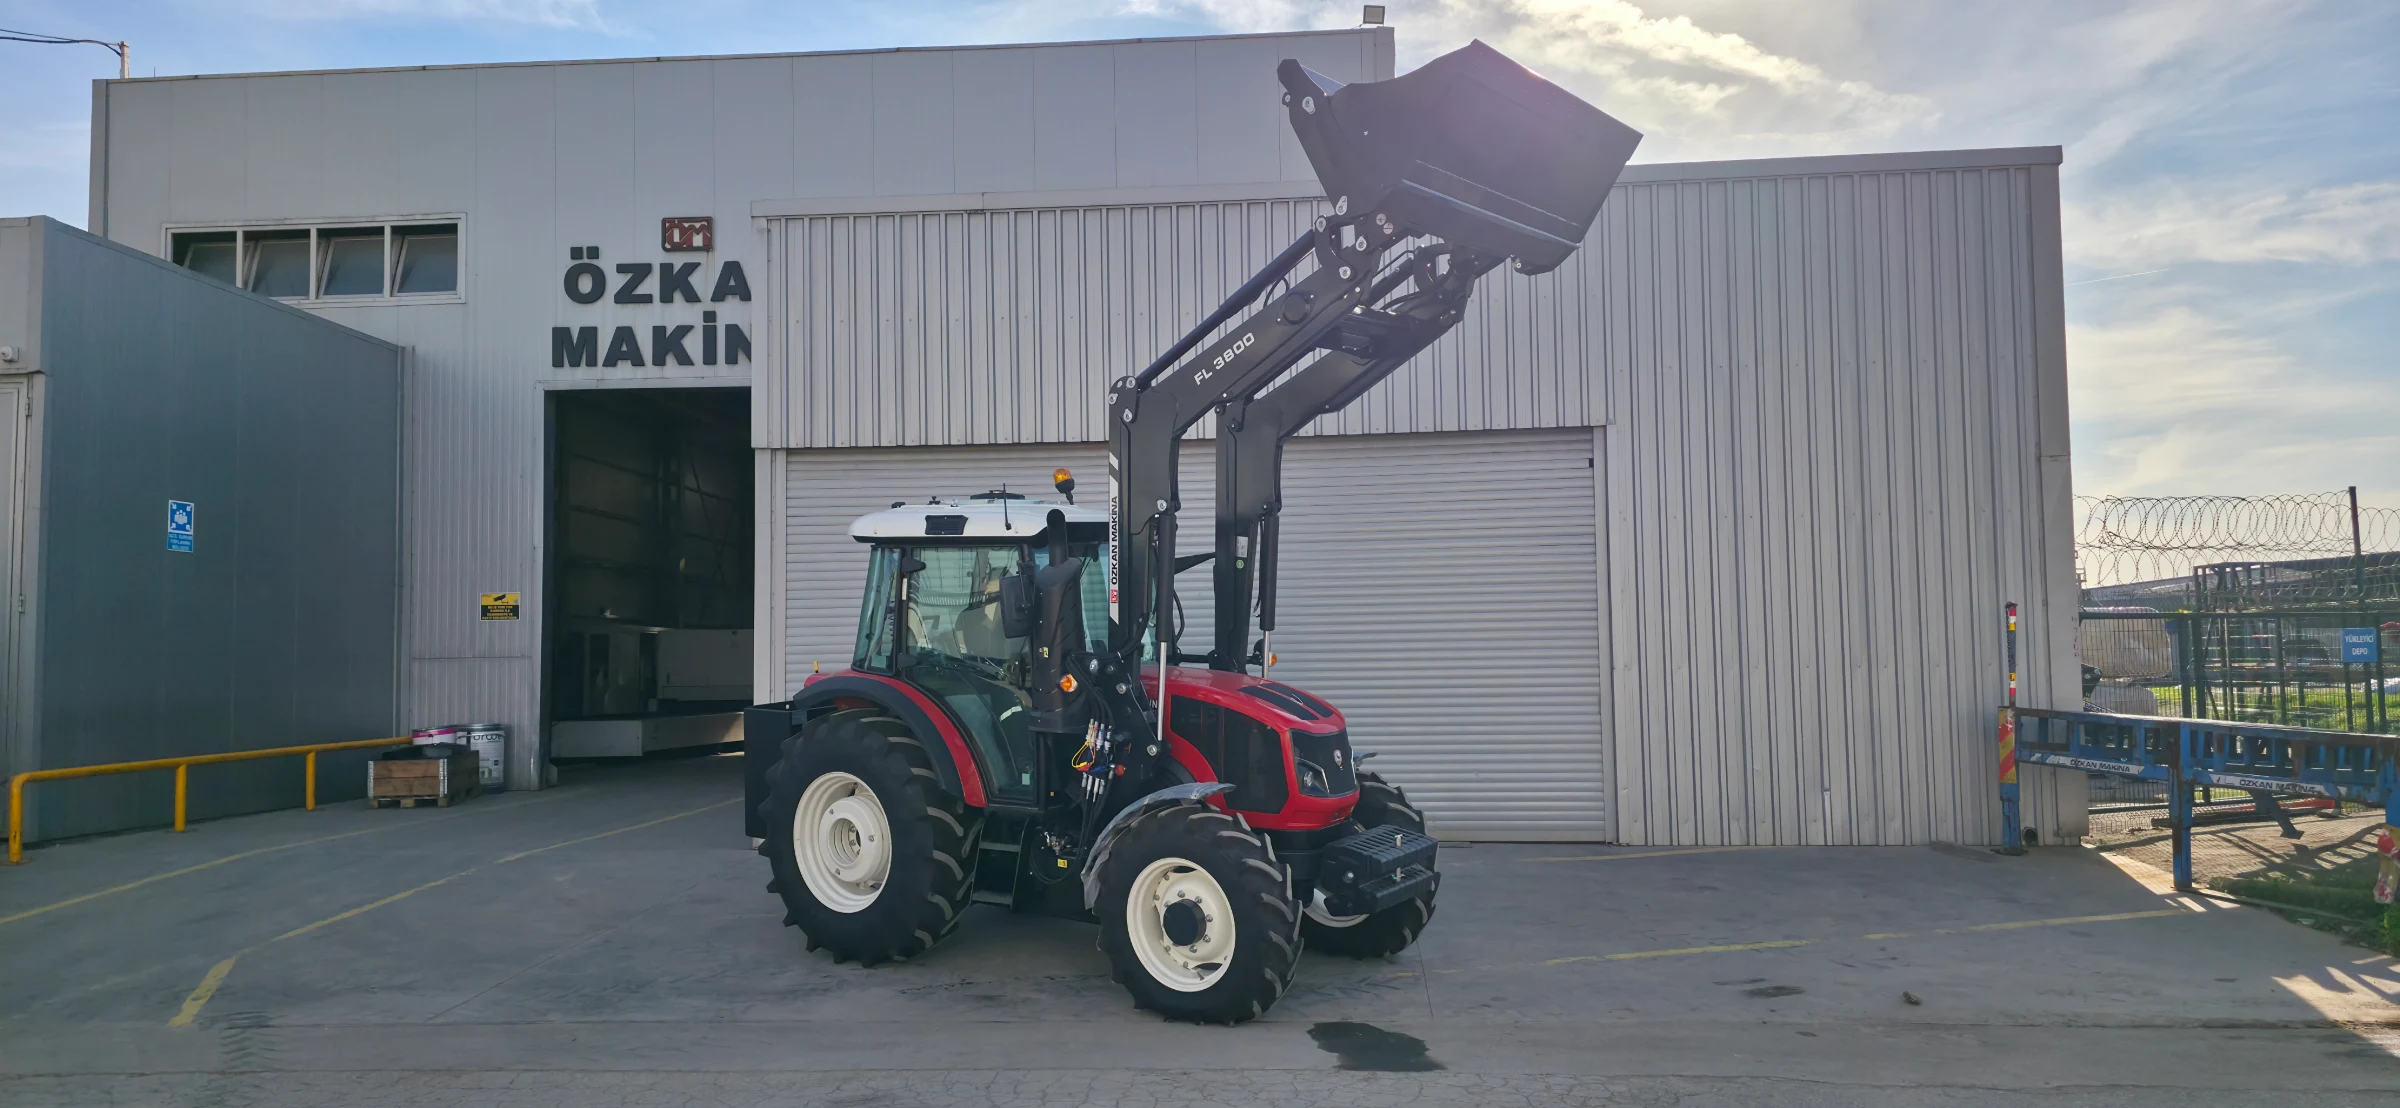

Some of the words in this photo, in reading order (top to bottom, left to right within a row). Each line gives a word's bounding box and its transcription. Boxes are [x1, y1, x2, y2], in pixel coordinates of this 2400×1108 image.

[564, 246, 751, 304] ÖZKA
[1194, 368, 1213, 386] FL
[1213, 332, 1255, 370] 3800
[2352, 647, 2368, 655] DEPO
